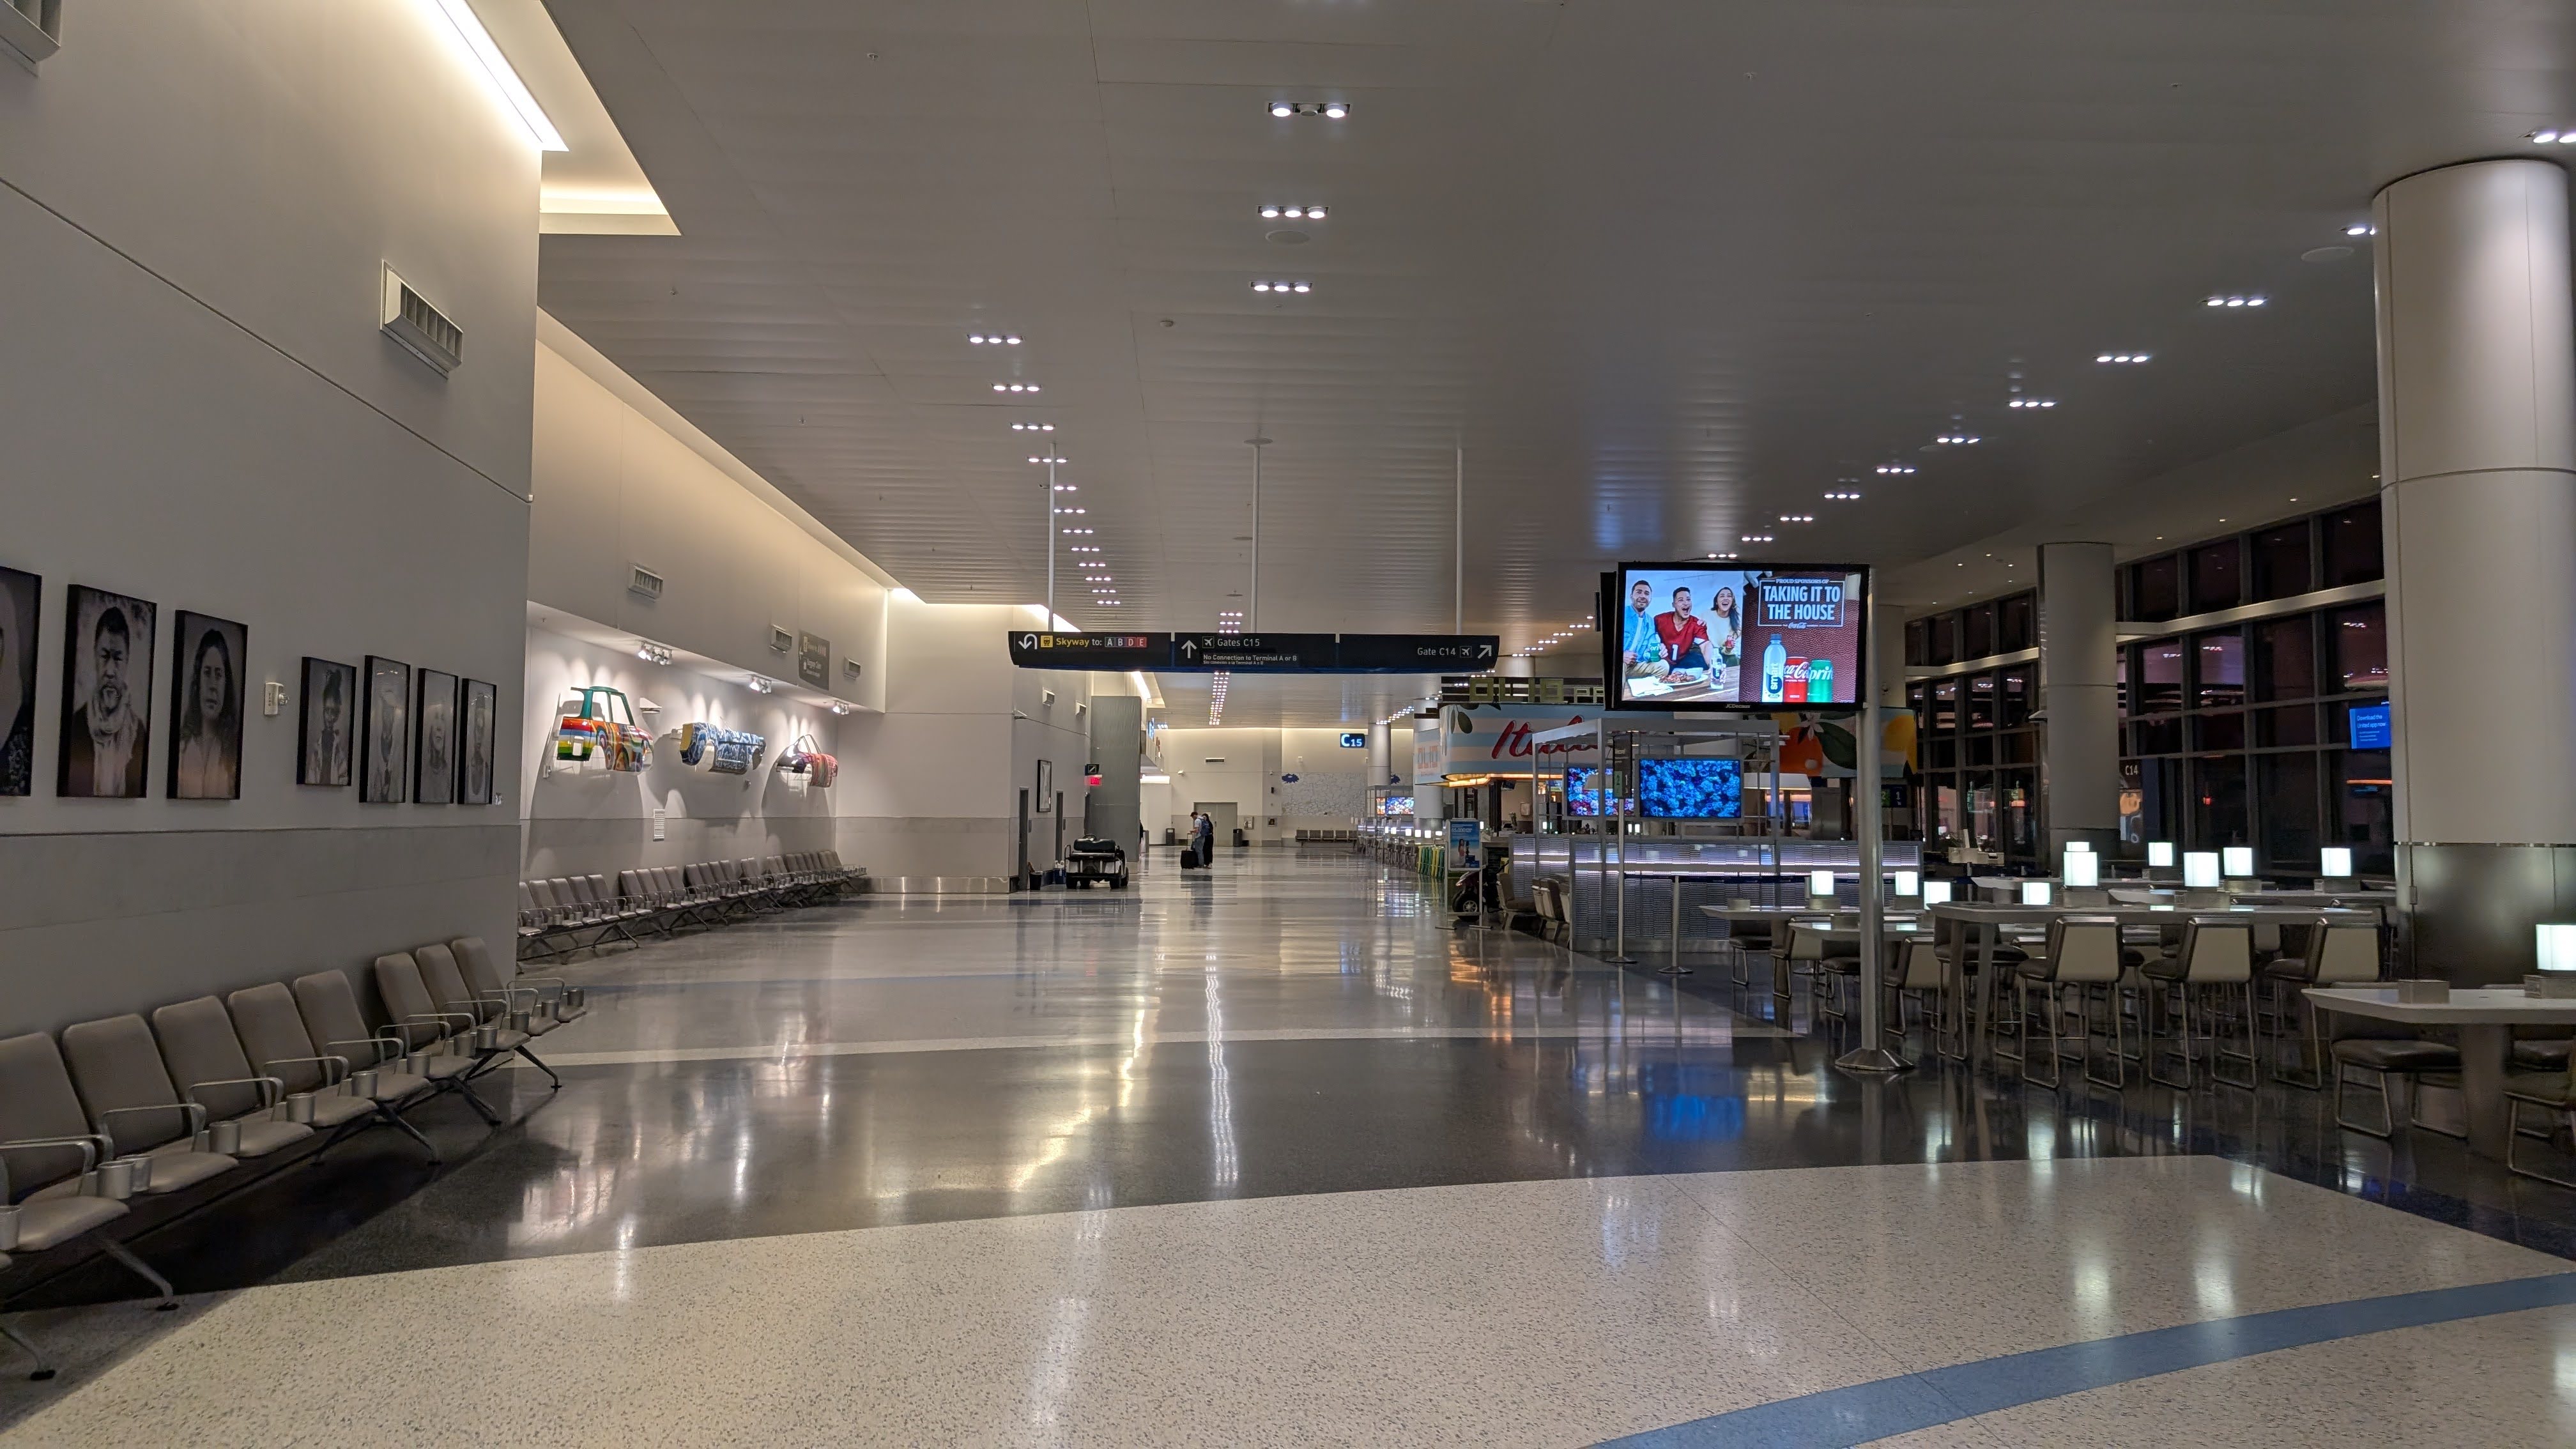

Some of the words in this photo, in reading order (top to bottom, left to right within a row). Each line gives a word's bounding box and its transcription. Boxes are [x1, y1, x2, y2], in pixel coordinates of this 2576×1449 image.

[1763, 586, 1808, 602] TAKING
[1811, 586, 1823, 602] IT
[1825, 586, 1840, 602] TO
[1767, 604, 1791, 620] THE
[1794, 604, 1836, 620] HOUSE
[1056, 638, 1089, 648] Skyway
[1217, 638, 1240, 647] Gates
[1243, 638, 1260, 647] C15
[1417, 647, 1436, 656] Gate
[1439, 647, 1456, 656] C14
[1341, 734, 1363, 747] C15
[2125, 765, 2138, 776] C14
